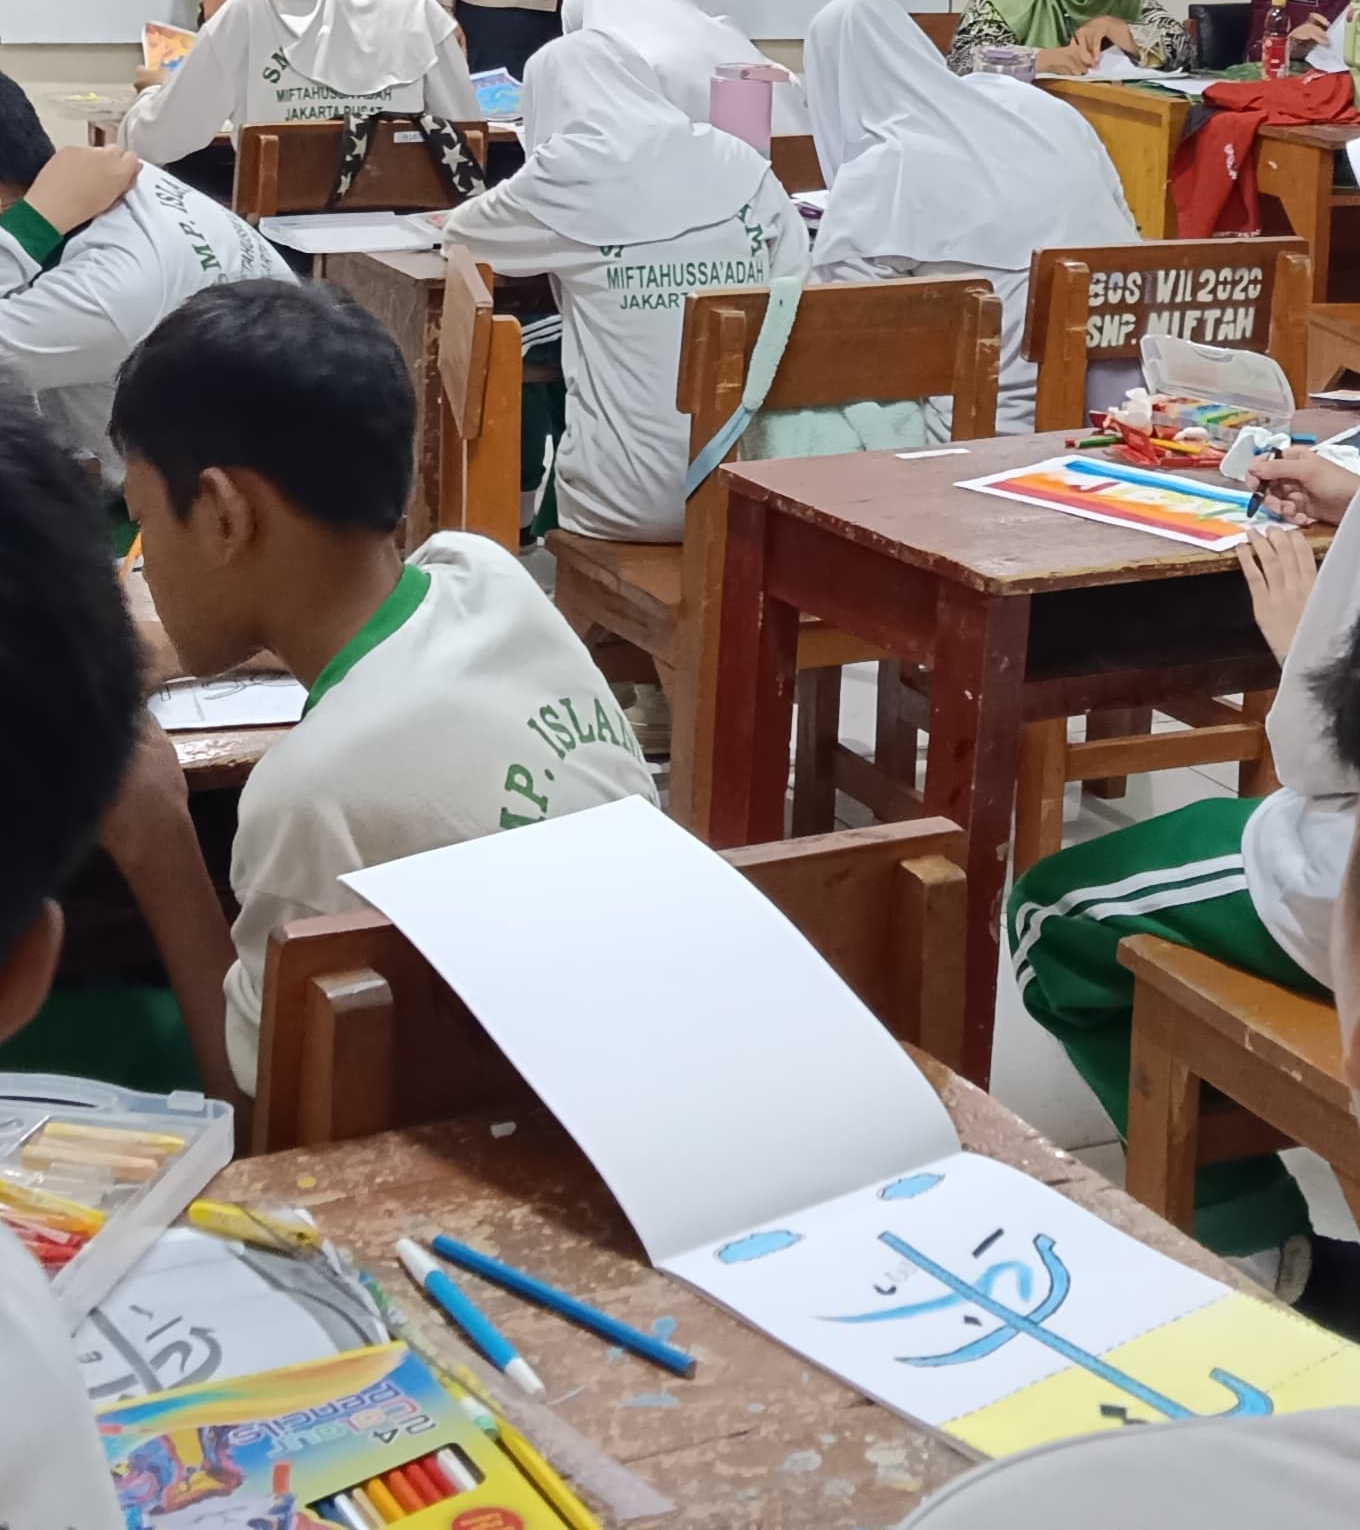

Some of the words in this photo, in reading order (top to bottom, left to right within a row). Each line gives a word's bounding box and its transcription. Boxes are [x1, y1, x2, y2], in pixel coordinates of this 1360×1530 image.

[606, 260, 764, 290] MIFTAHUSSA'ADAH
[1196, 266, 1263, 303] 2020
[1146, 306, 1256, 343] MIFTAH
[371, 1412, 437, 1445] 24
